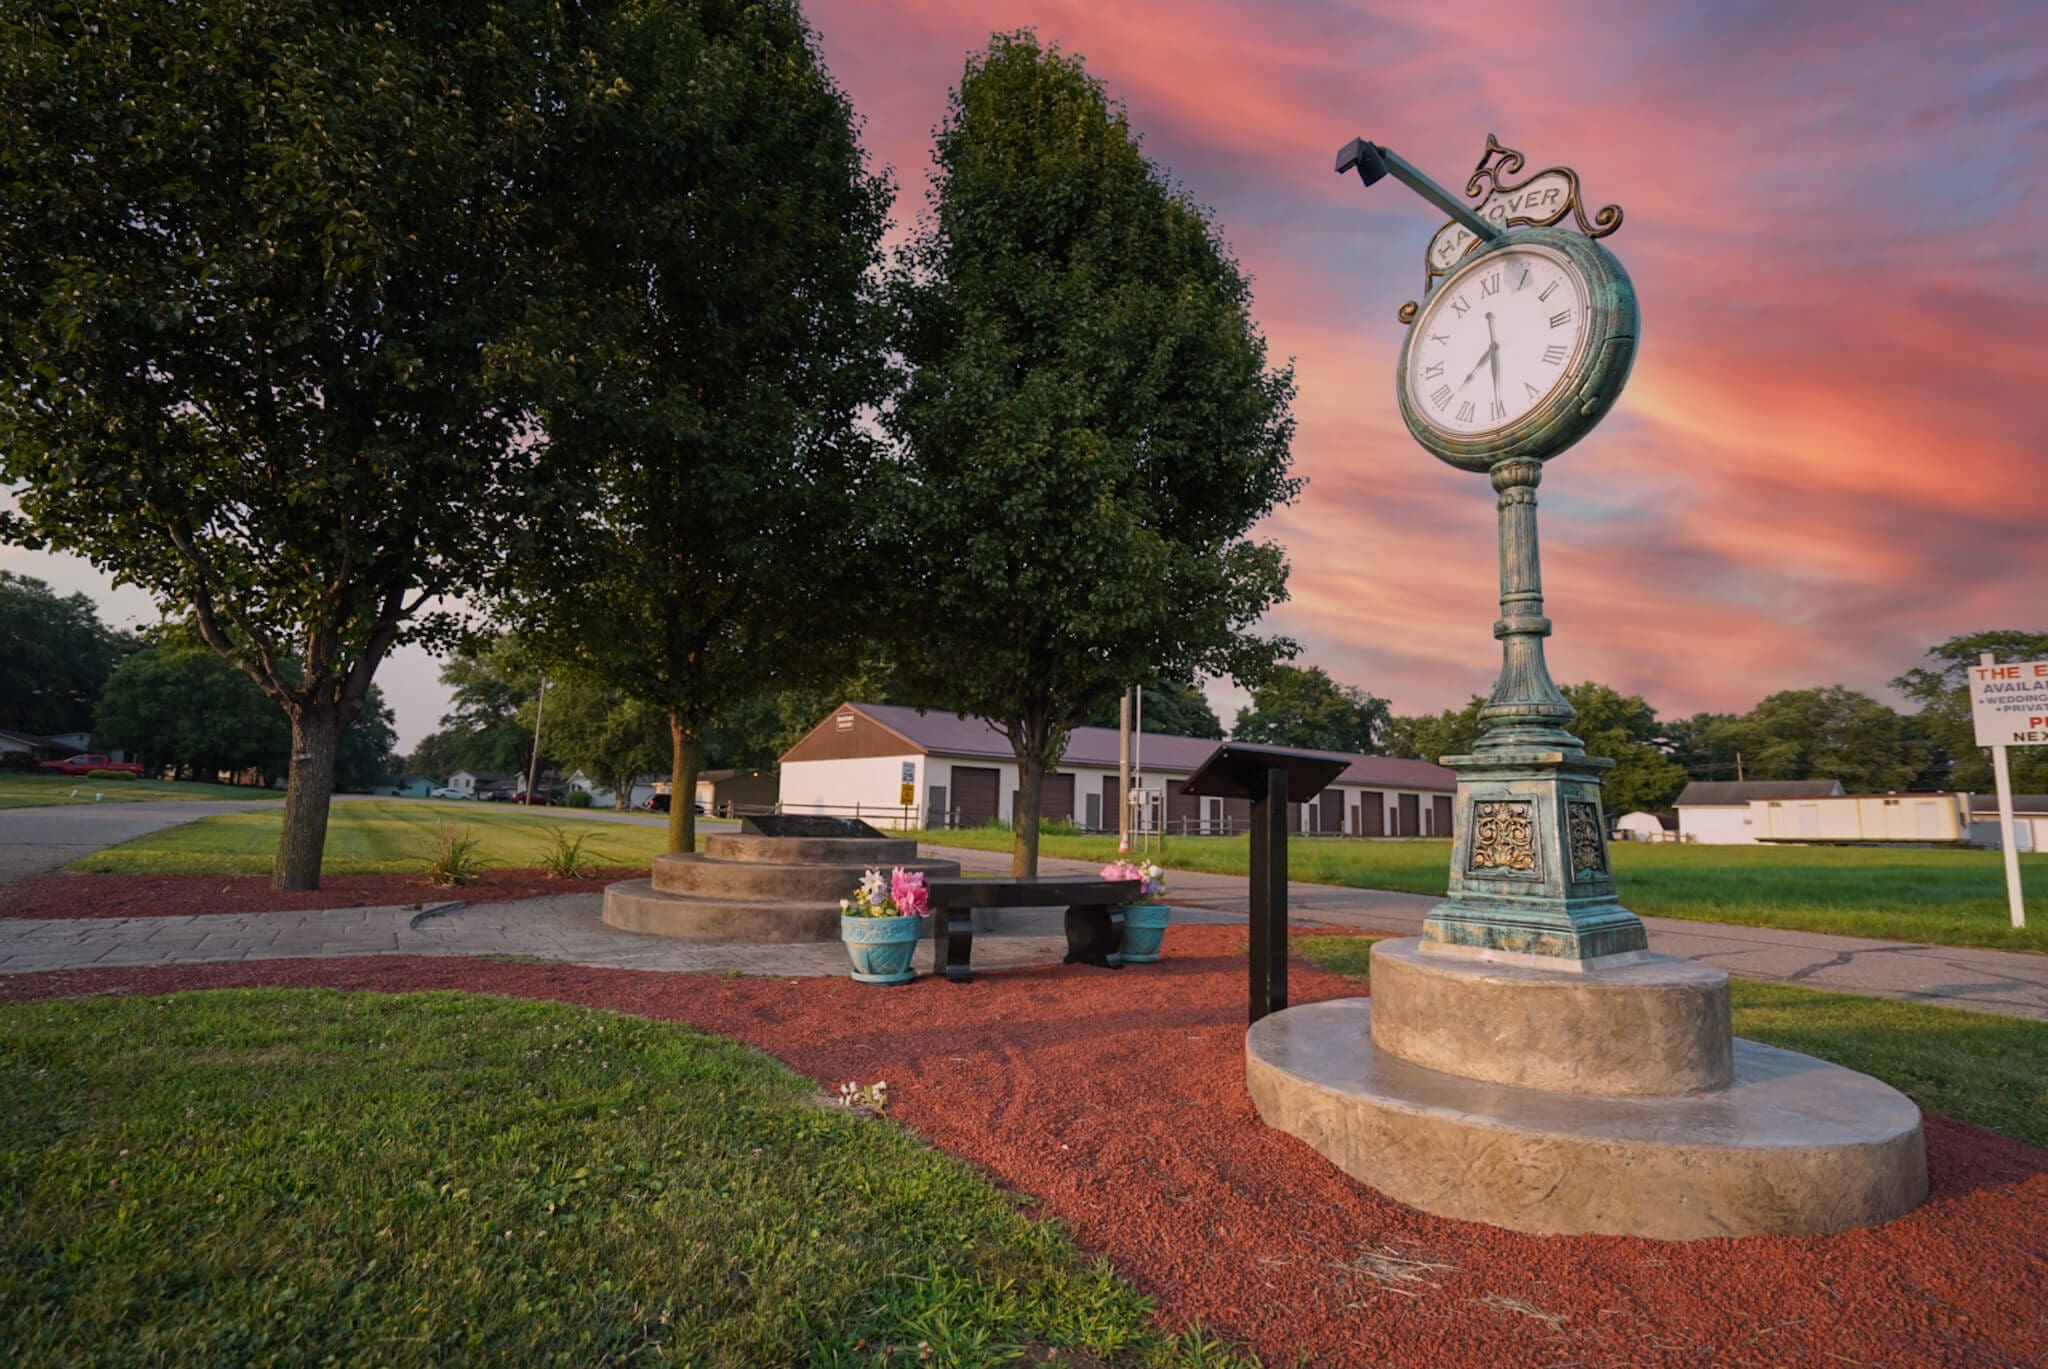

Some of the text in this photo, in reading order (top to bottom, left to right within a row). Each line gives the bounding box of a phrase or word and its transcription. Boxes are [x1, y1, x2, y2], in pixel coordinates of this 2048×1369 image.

[1438, 188, 1560, 259] HAOVER
[1480, 272, 1501, 300] XII
[1538, 280, 1559, 302] II
[1450, 295, 1471, 320] XI
[1549, 309, 1572, 329] III
[1431, 333, 1451, 346] X
[1425, 360, 1445, 380] IX
[1523, 382, 1541, 400] V
[1975, 667, 2021, 680] THE
[1984, 681, 2048, 693] AVAILA
[2029, 716, 2048, 729] P
